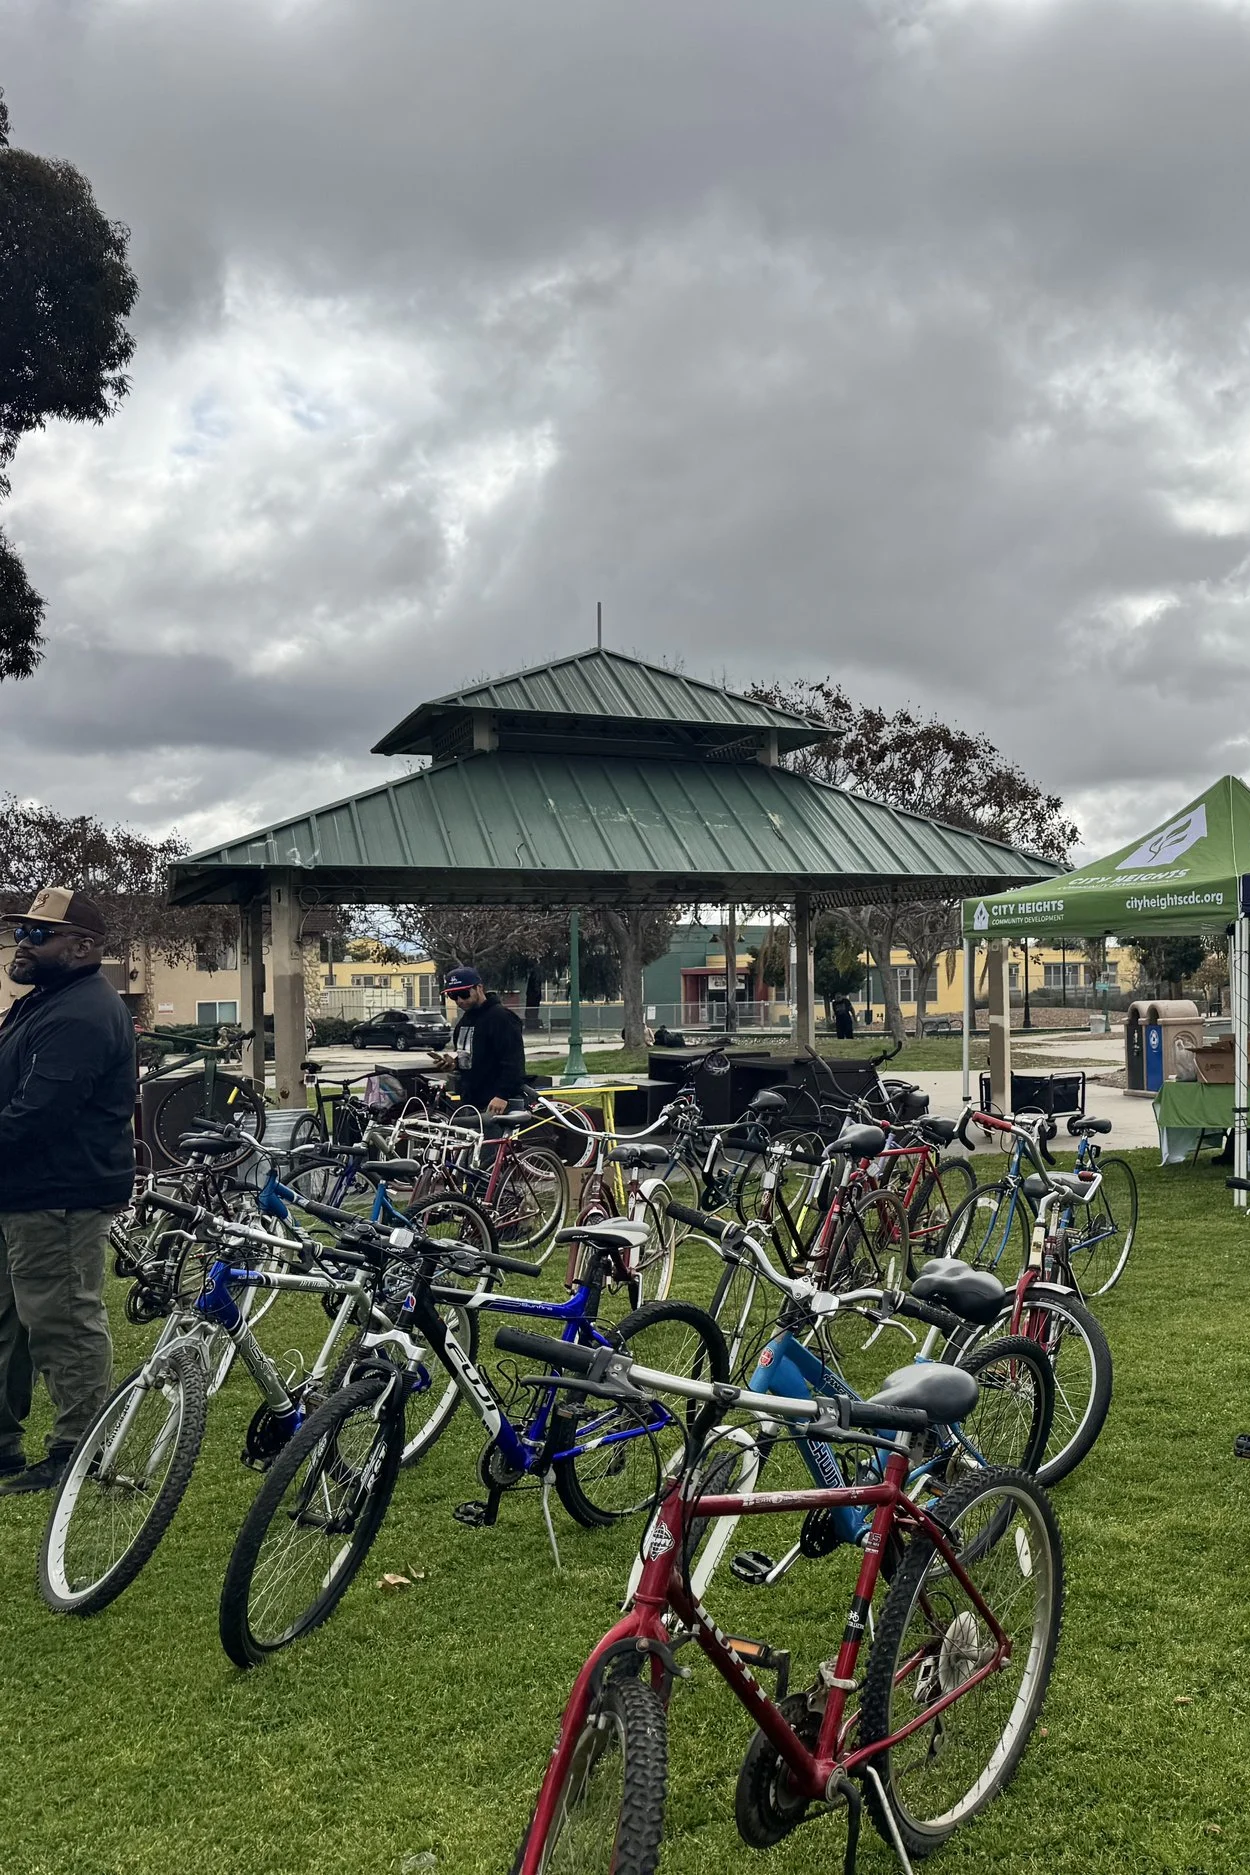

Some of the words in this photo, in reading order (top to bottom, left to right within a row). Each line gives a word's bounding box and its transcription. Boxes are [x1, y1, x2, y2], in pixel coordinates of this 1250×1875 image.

[1069, 877, 1112, 885] CITY
[1112, 869, 1191, 882] HEIGHTS
[991, 904, 1015, 917] CITY
[1018, 900, 1065, 915] HEIGHTS
[1125, 891, 1224, 912] cityheightscdc.org
[991, 917, 1024, 926] COMMUNITY
[1023, 914, 1065, 924] DEVELOPMENT
[521, 1302, 553, 1311] Sunfire
[243, 1331, 277, 1377] NEXT
[446, 1342, 498, 1412] FUJI
